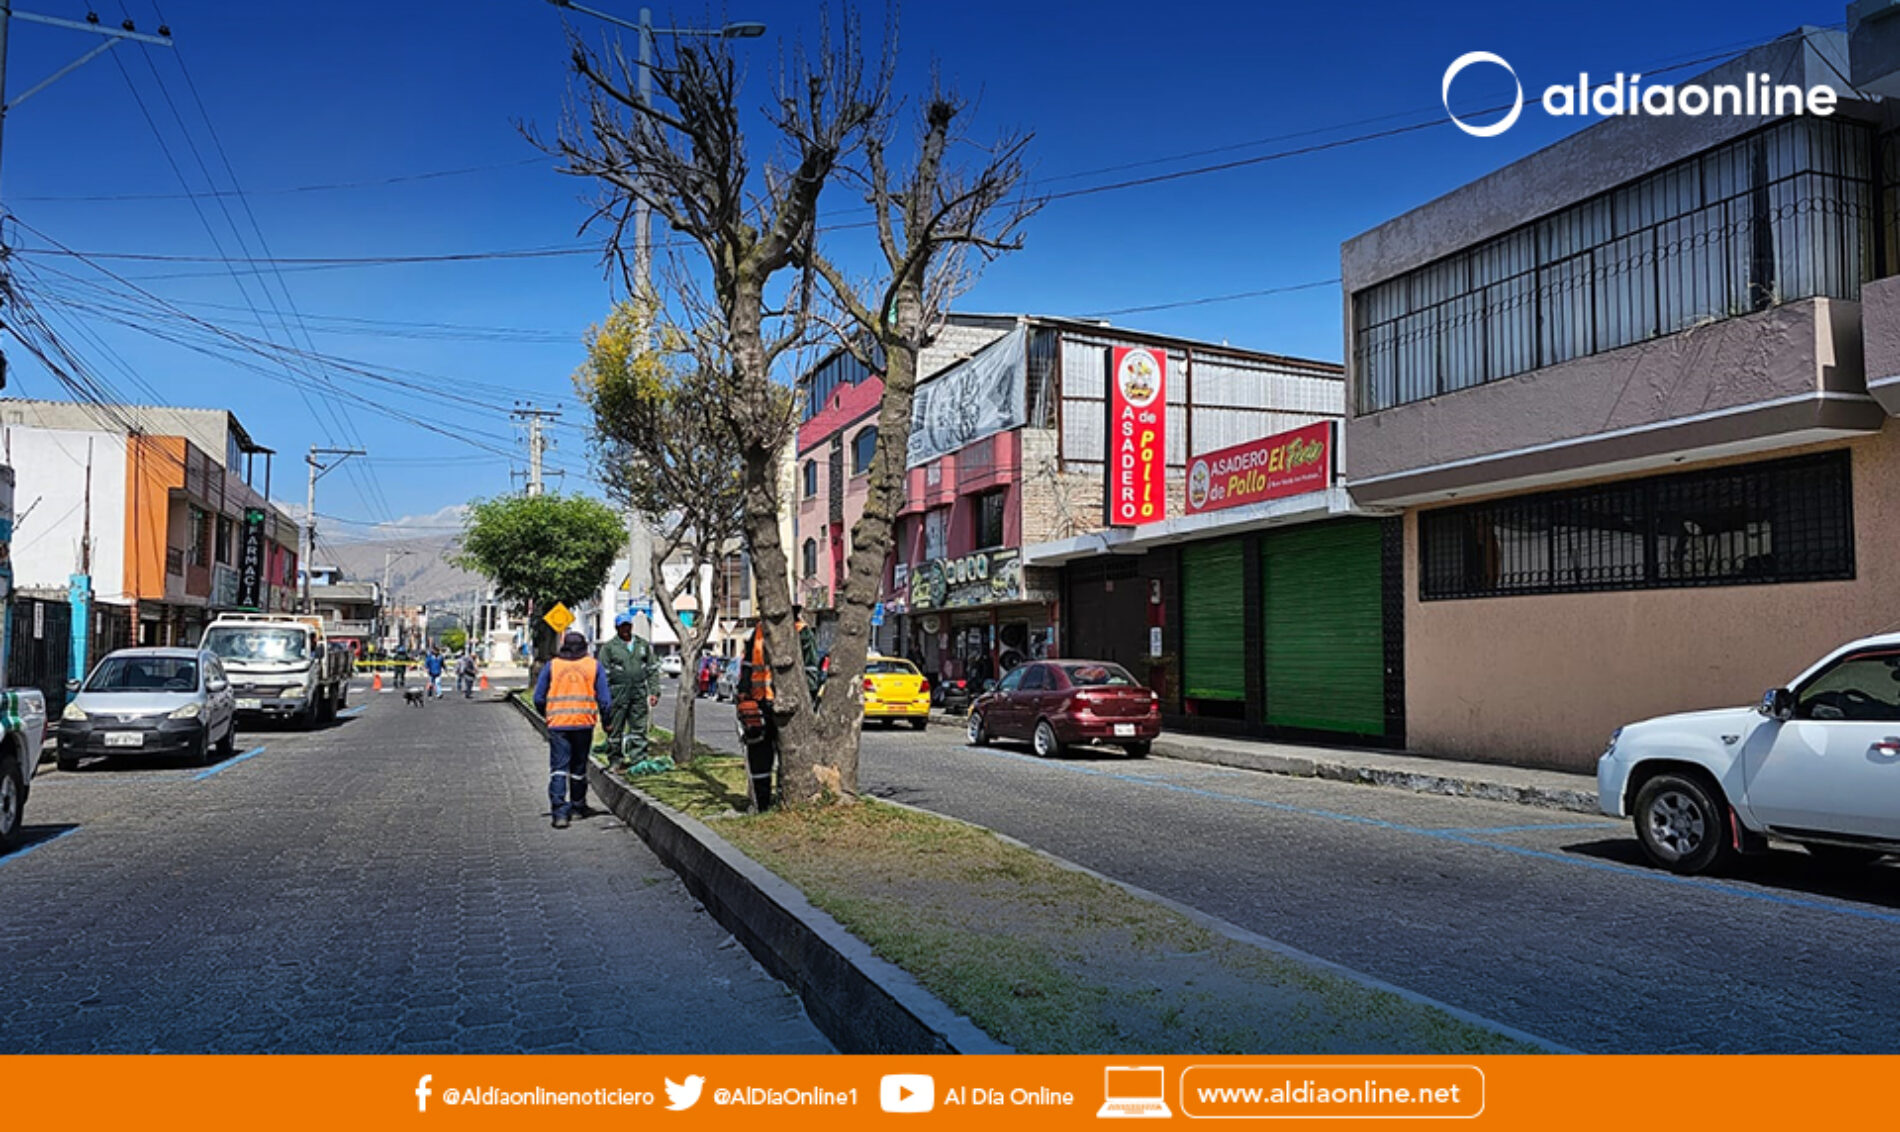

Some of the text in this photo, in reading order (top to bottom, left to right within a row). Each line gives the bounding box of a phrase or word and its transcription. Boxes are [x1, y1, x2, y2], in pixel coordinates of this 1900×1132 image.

[1138, 411, 1156, 423] de
[1121, 405, 1136, 518] ASADERO
[1140, 430, 1155, 517] Pollo
[1210, 448, 1268, 477] ASADERO
[1268, 444, 1285, 473] El
[1210, 486, 1226, 500] de
[1227, 469, 1266, 497] Pollo
[243, 526, 258, 605] FARMACIA
